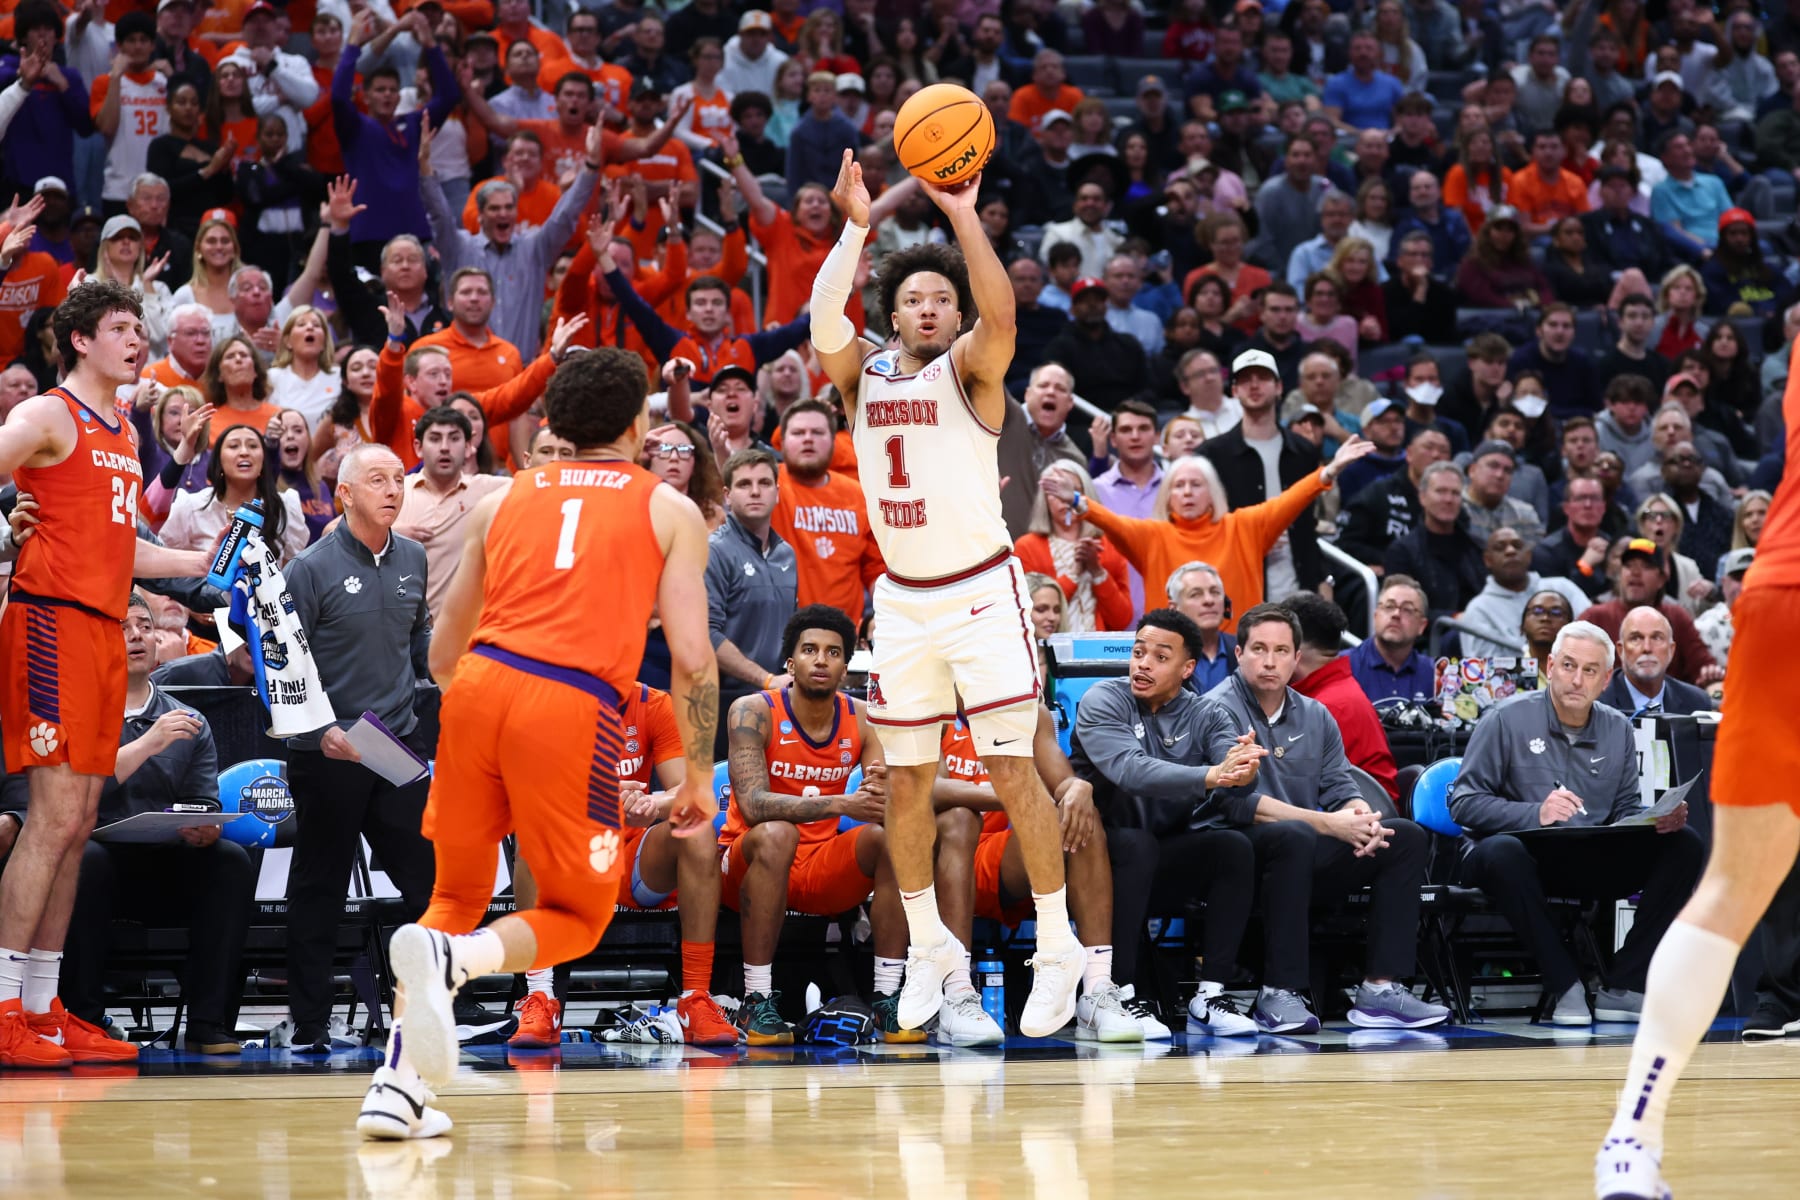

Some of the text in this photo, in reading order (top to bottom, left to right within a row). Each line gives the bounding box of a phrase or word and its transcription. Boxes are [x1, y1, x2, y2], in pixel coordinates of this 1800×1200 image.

[134, 110, 158, 136] 32
[934, 145, 977, 179] NCAA
[925, 365, 940, 380] SEC
[866, 400, 938, 427] RIMSON
[885, 434, 910, 488] 1
[535, 468, 632, 490] C. HUNTER
[112, 476, 137, 528] 24
[879, 498, 927, 528] TIDE
[214, 519, 244, 573] POWERADE
[554, 498, 584, 569] 1
[279, 678, 306, 694] FINAL
[281, 693, 304, 705] ROAD
[946, 755, 988, 776] CLEM
[252, 788, 285, 798] MARCH
